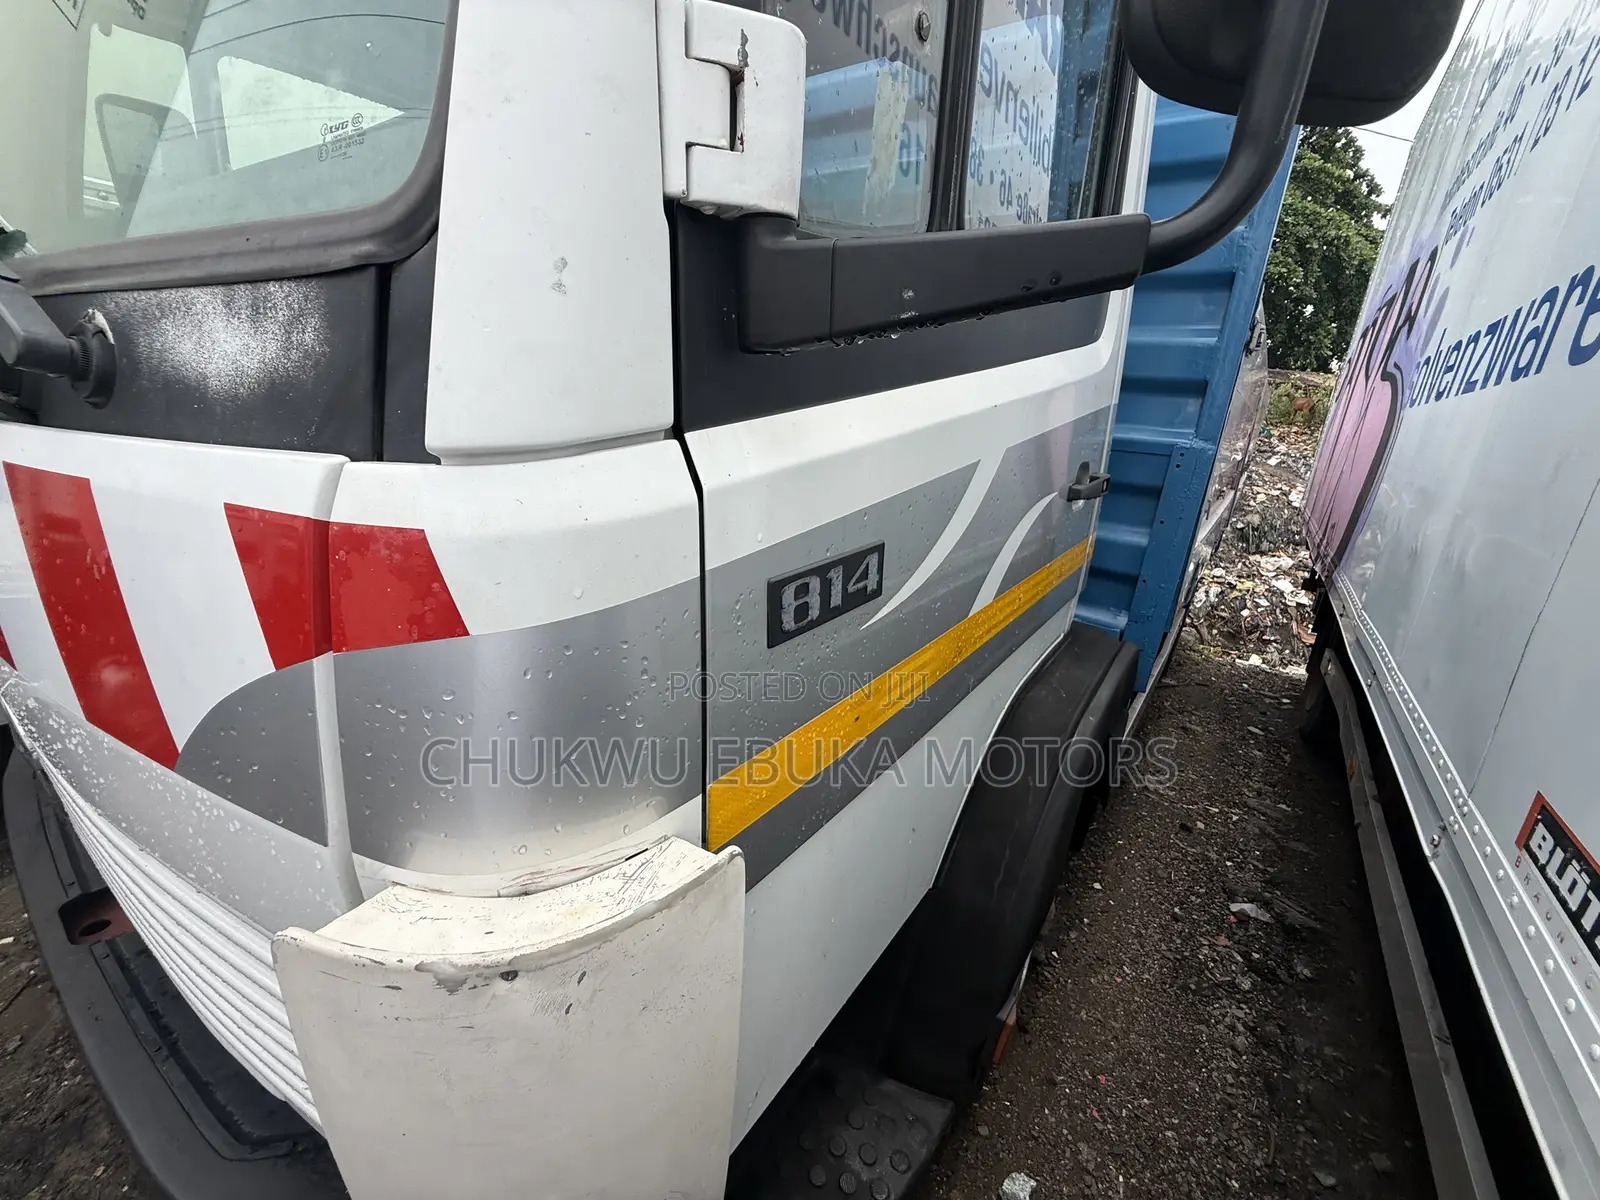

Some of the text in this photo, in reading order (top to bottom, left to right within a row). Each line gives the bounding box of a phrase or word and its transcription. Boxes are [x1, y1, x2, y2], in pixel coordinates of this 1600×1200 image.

[1530, 65, 1573, 153] 23
[780, 552, 880, 632] 814
[1529, 821, 1600, 950] BLÖT
